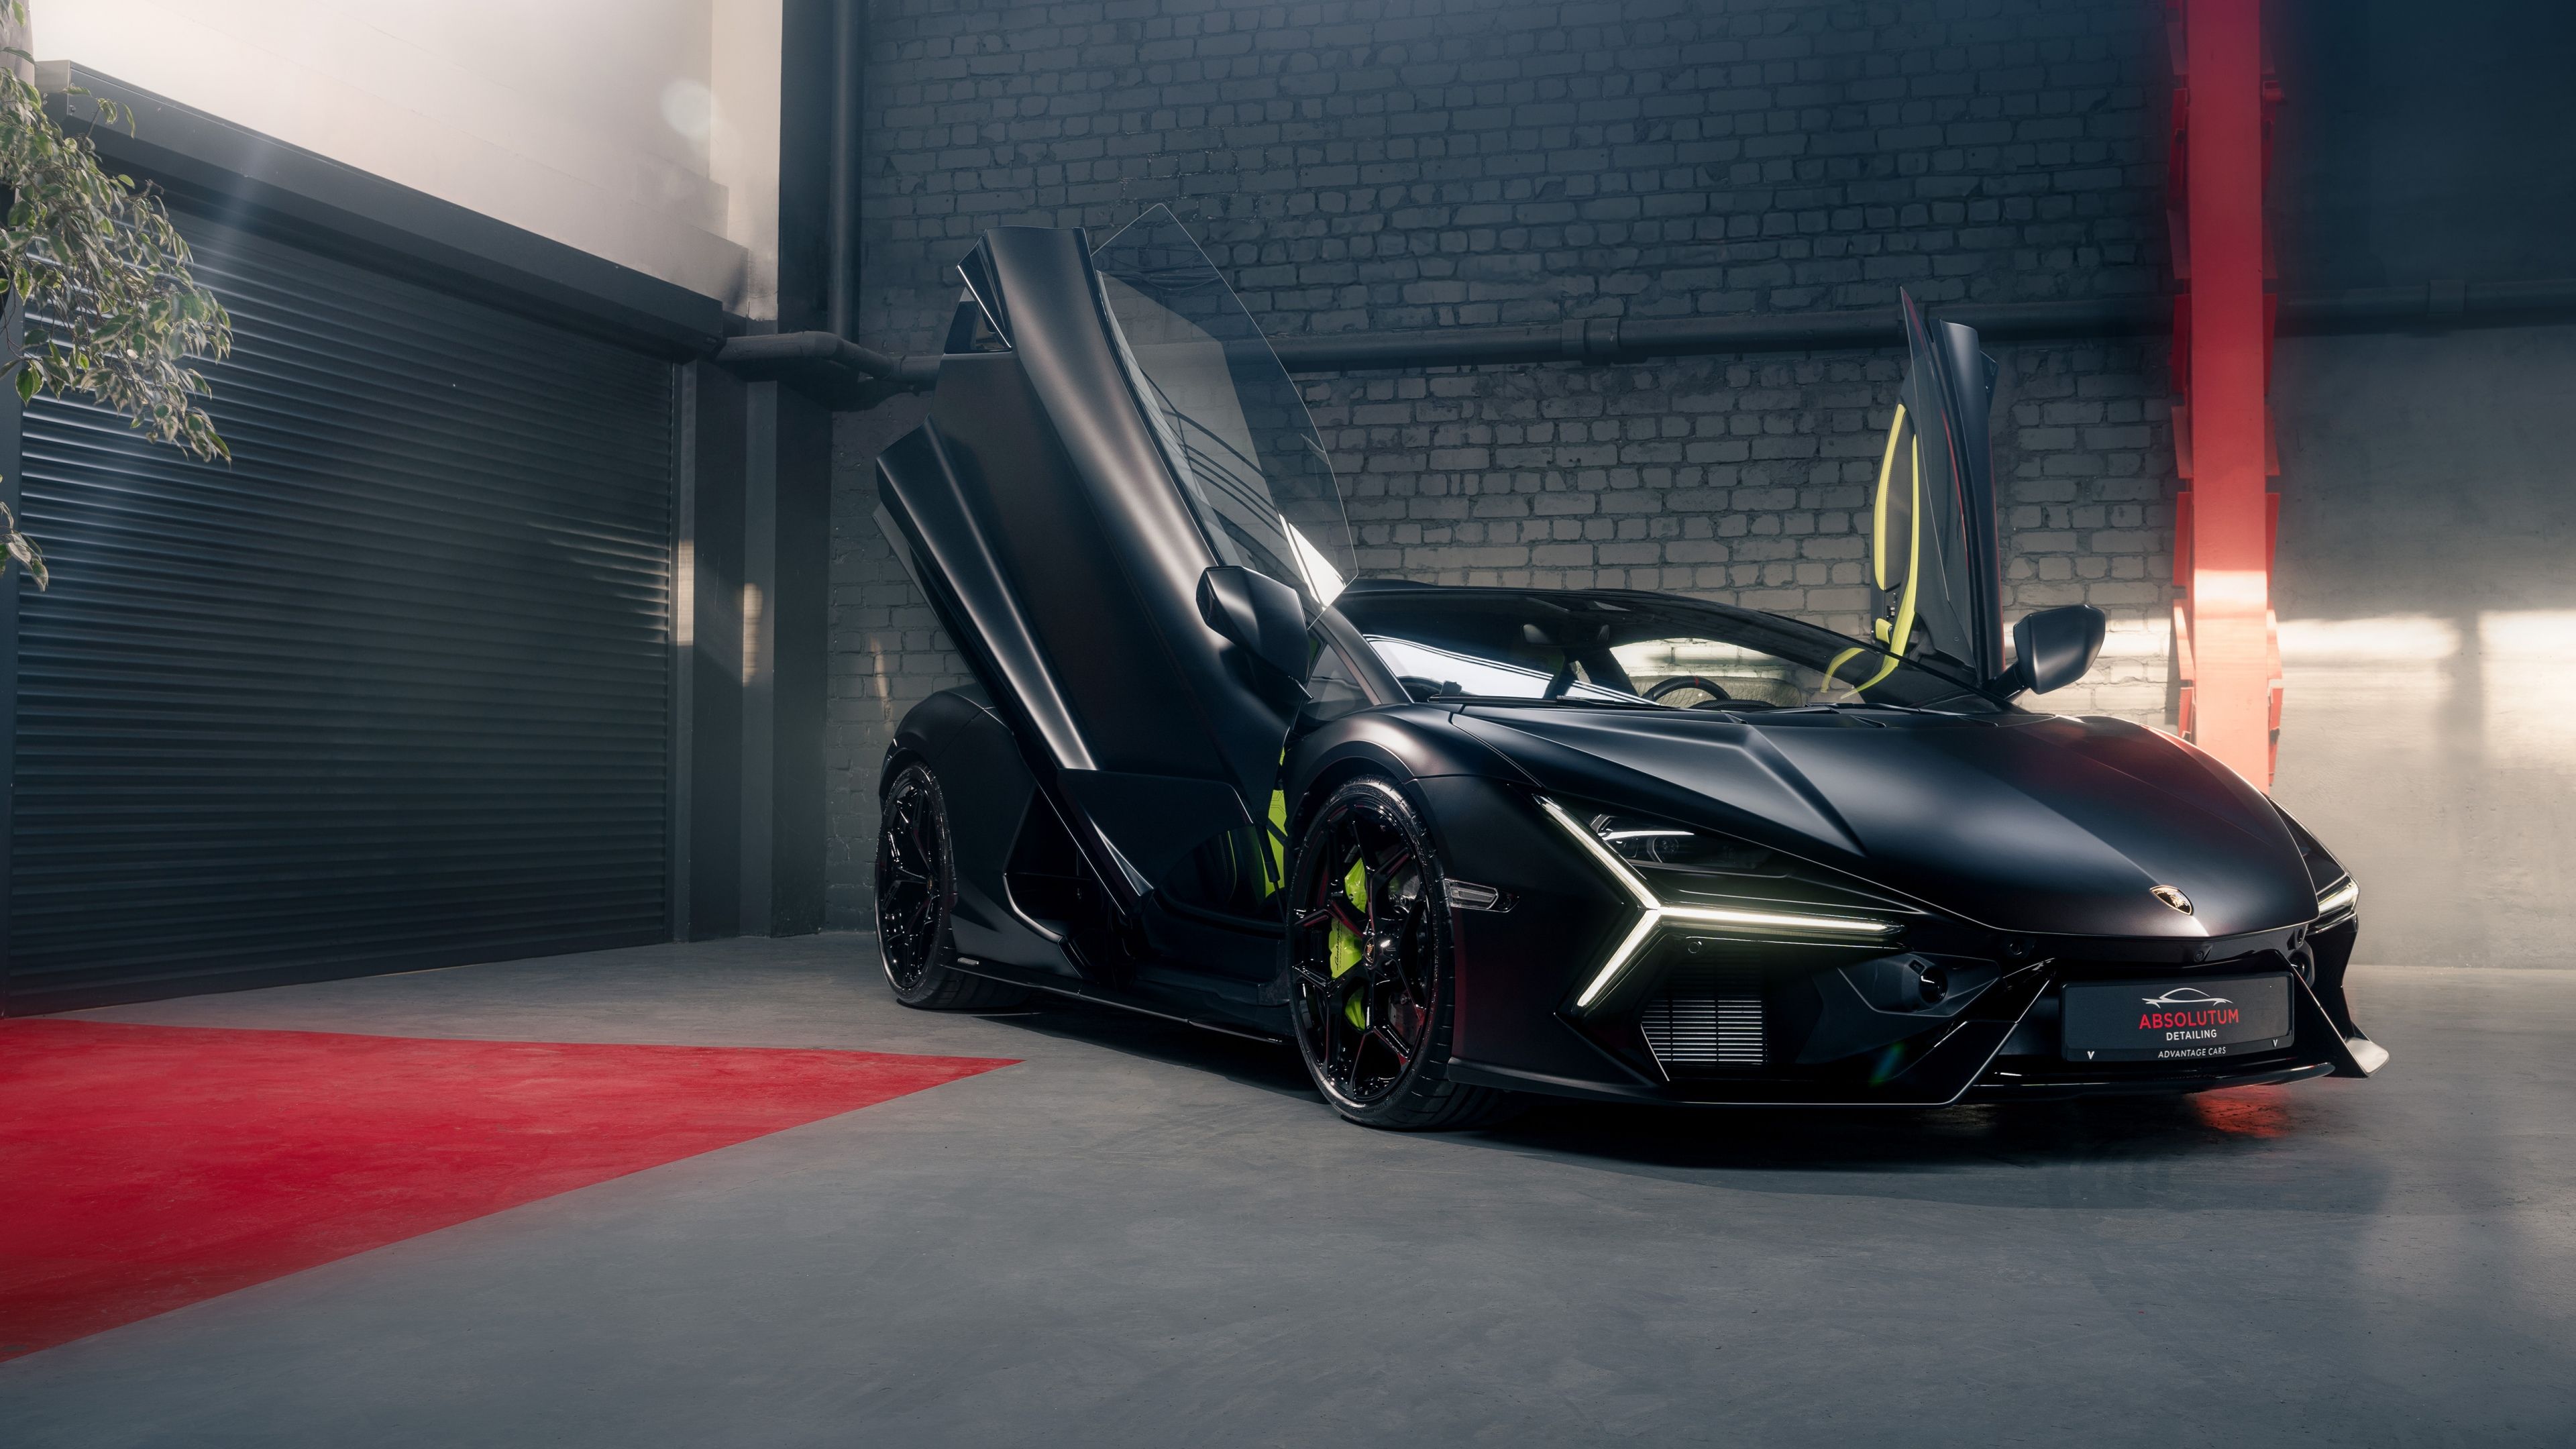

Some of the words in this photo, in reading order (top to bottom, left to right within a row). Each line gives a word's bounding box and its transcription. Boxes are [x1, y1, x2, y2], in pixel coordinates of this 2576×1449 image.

[2139, 1008, 2239, 1029] ABSOLUTUM
[2166, 1029, 2217, 1040] DETAILING
[2158, 1048, 2206, 1058] ADVANTAGE
[2208, 1046, 2226, 1056] CARS
